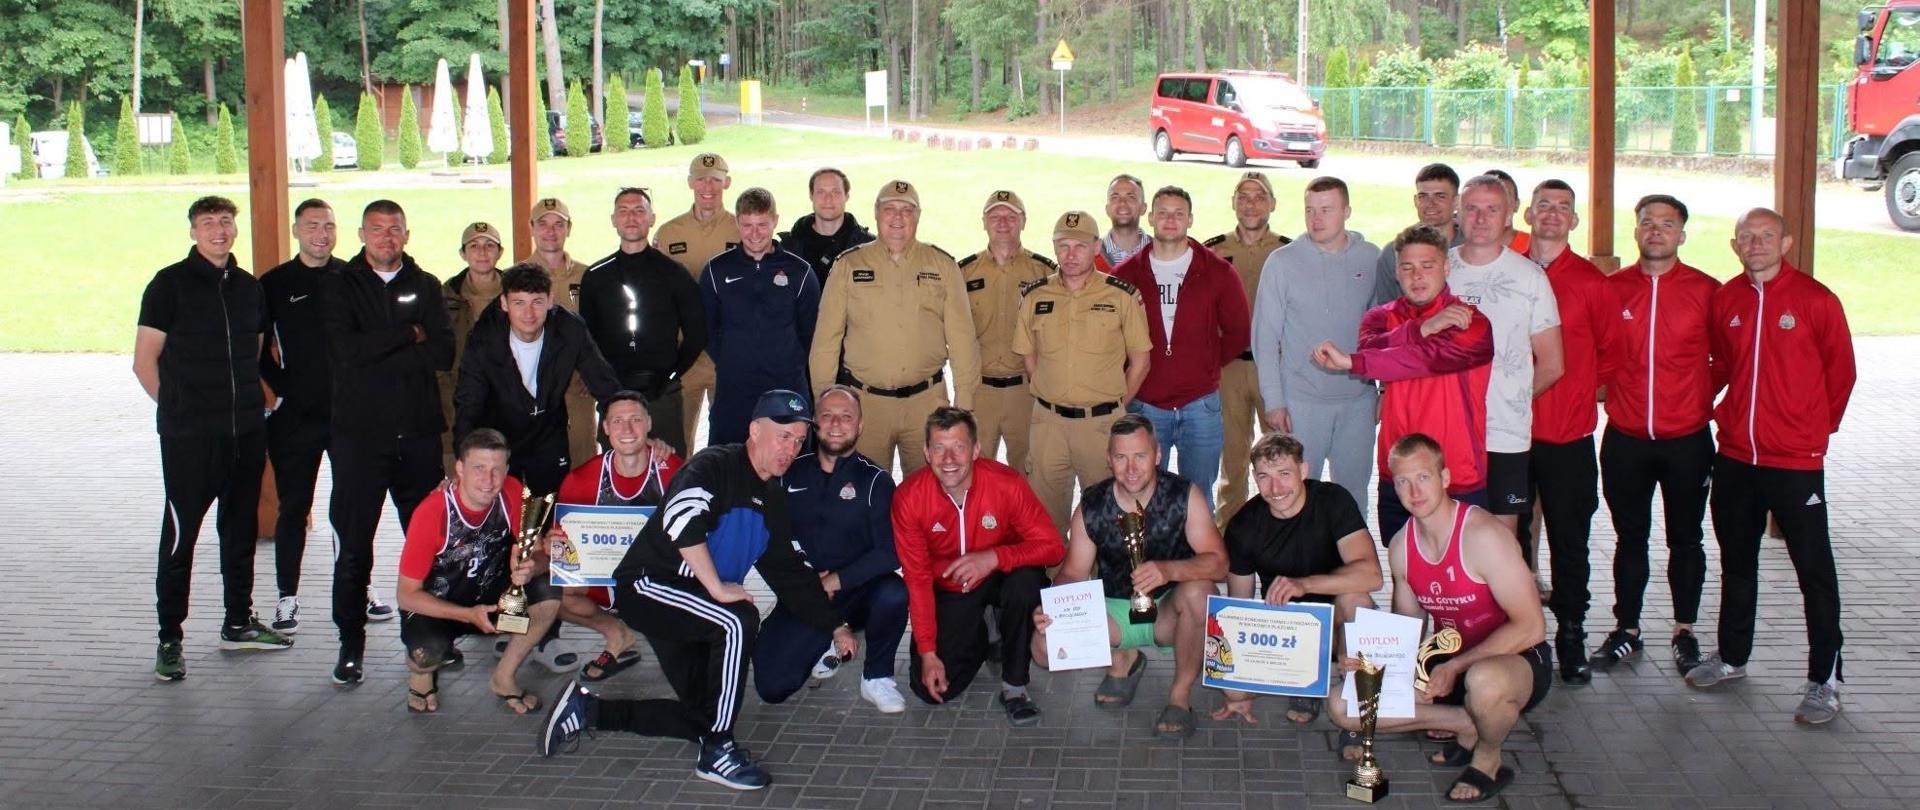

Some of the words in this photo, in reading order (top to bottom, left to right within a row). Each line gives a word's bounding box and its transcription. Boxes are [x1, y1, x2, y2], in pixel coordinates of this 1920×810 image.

[581, 533, 589, 544] 5
[592, 533, 617, 545] 000
[467, 558, 478, 577] 2
[1446, 566, 1455, 581] 1
[1237, 631, 1246, 644] 3
[1250, 633, 1278, 647] 000
[1282, 635, 1297, 648] zł
